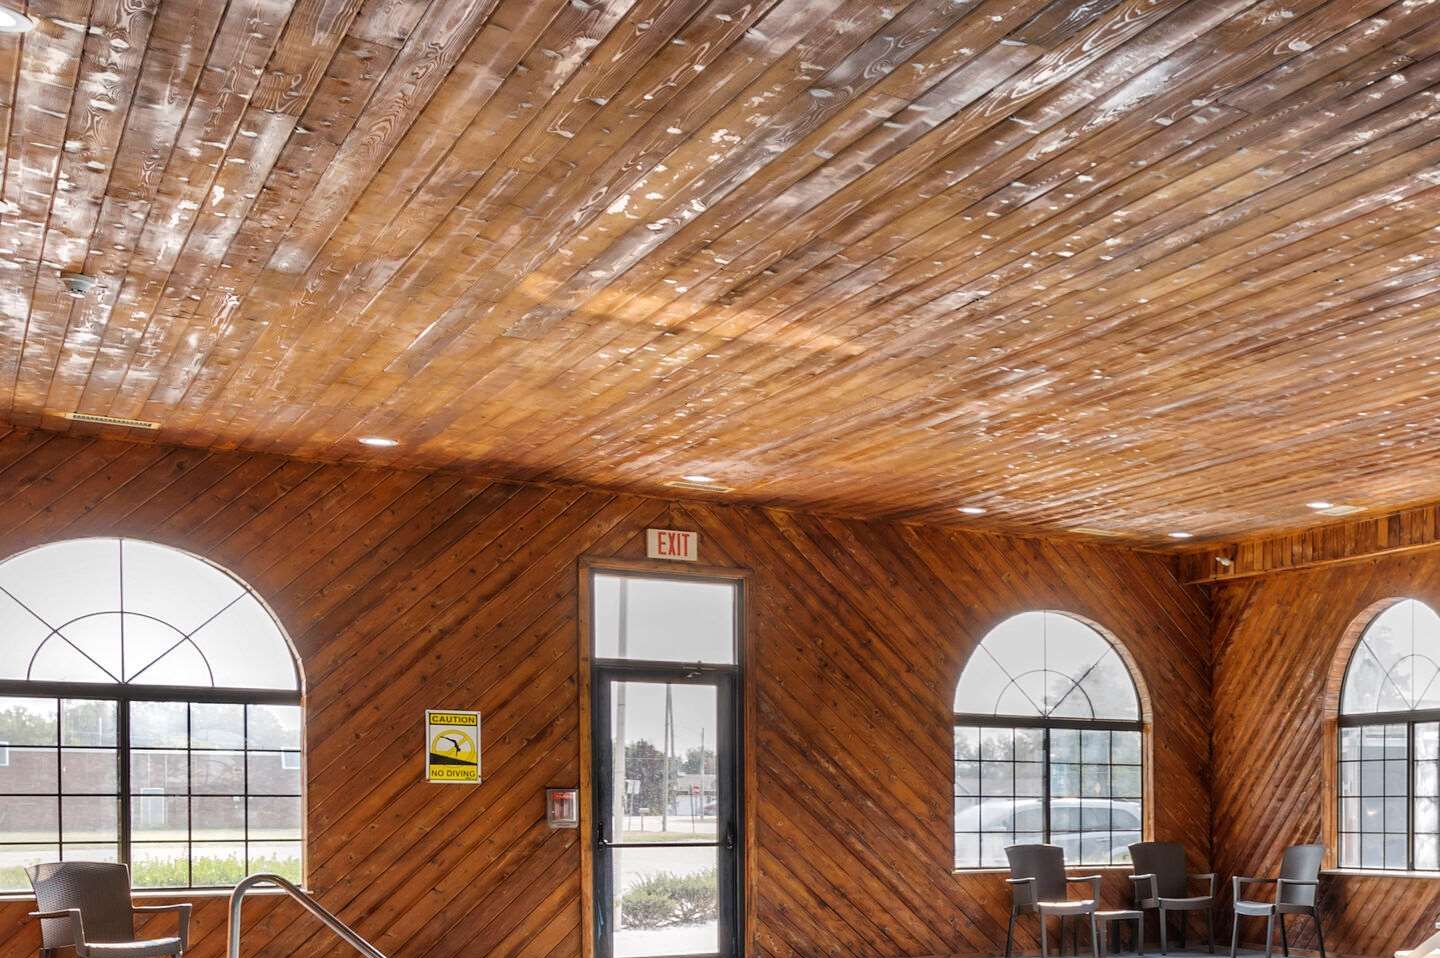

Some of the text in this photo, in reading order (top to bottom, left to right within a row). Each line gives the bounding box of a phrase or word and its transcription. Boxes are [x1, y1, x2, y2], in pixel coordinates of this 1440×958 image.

[657, 531, 690, 557] EXIT
[431, 716, 475, 724] CAUTION
[446, 769, 476, 778] DIVING
